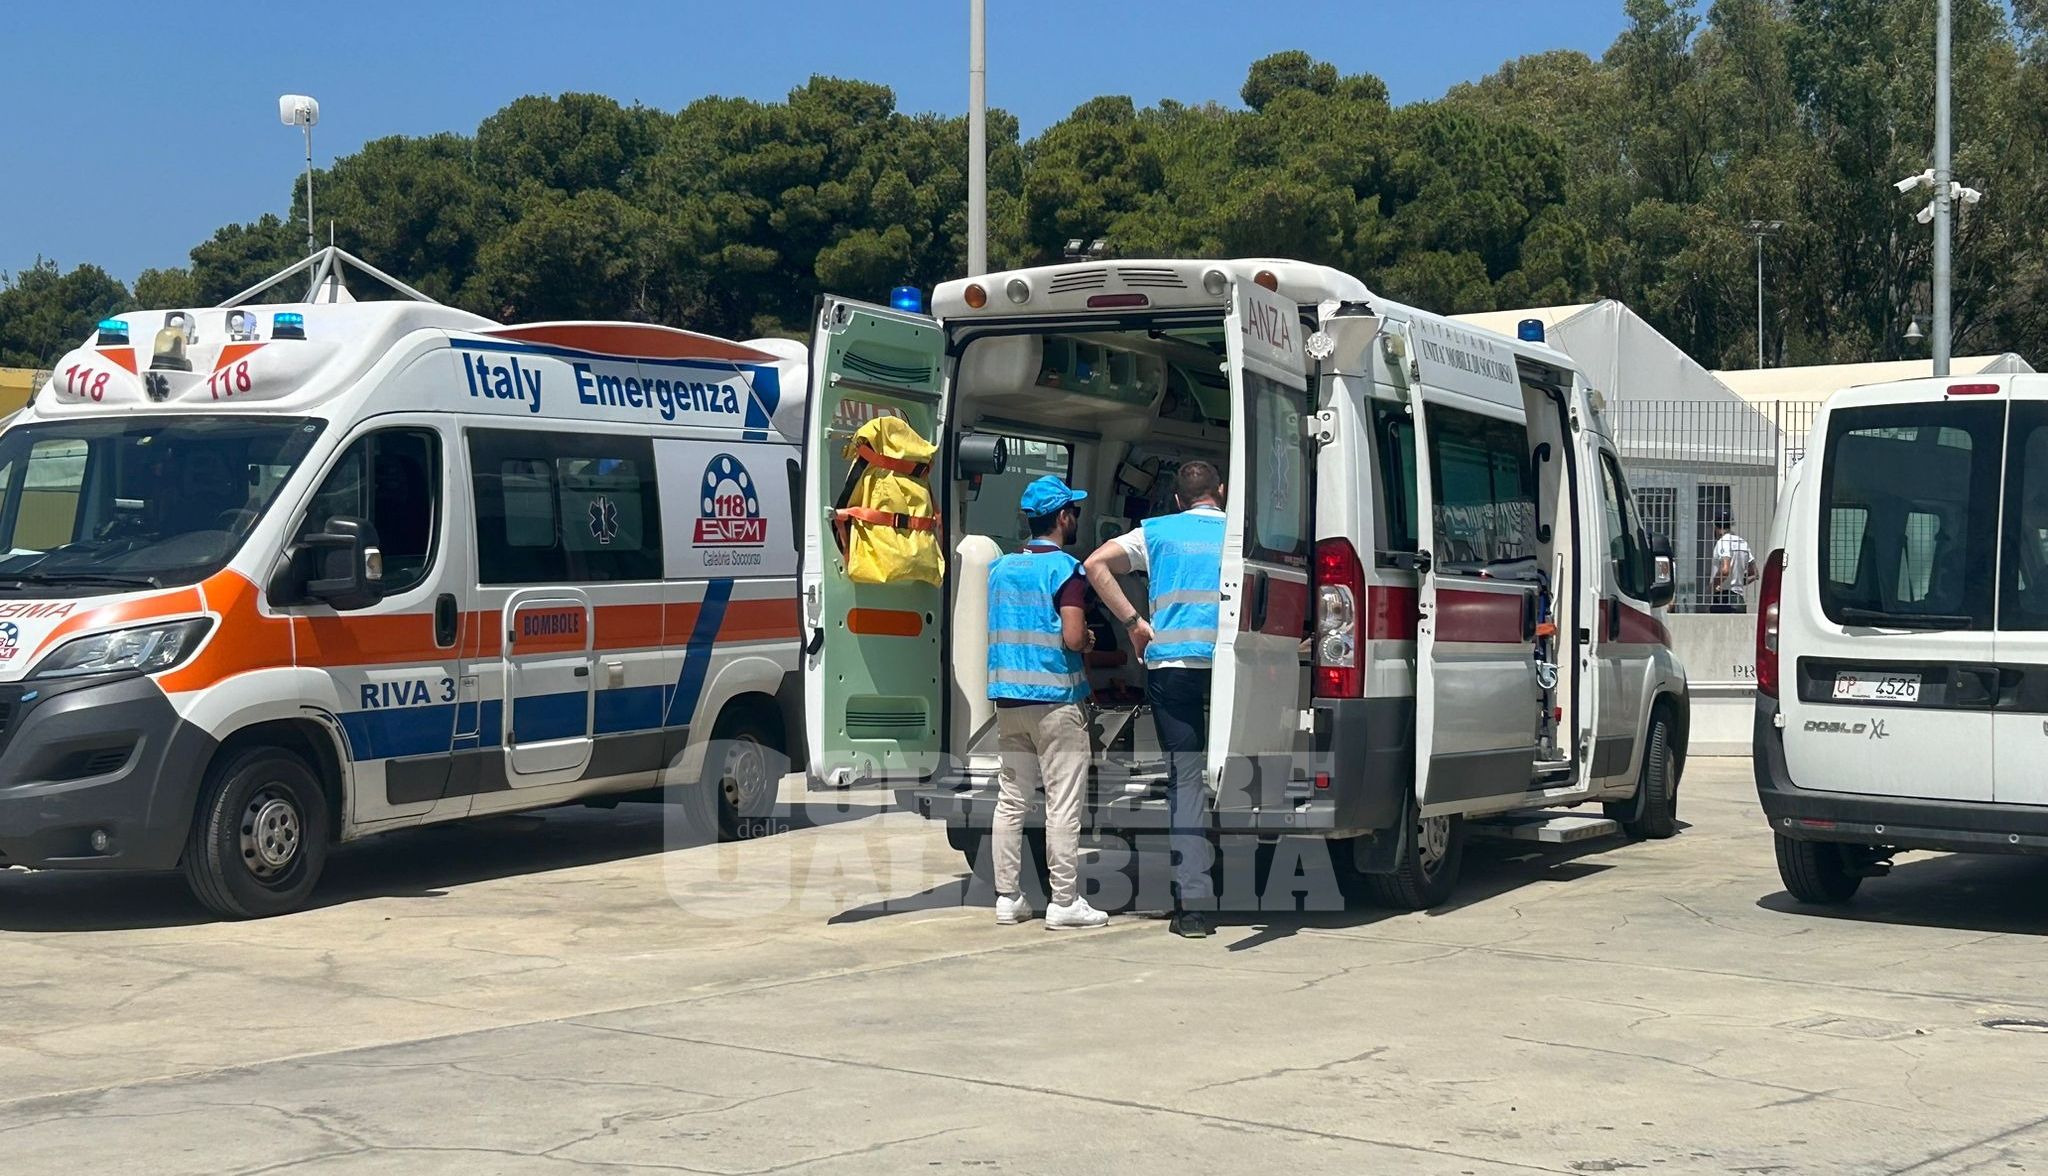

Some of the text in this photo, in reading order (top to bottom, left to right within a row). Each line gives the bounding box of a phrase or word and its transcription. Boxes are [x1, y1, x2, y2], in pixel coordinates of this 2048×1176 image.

[65, 364, 110, 401] 118
[207, 360, 251, 400] 118
[462, 352, 740, 421] Italy Emergenza
[715, 494, 745, 517] 118
[524, 613, 579, 636] BOMBOLE
[361, 678, 456, 709] RIVA 3
[1837, 676, 1915, 697] CP 4526
[1869, 718, 1890, 740] XL
